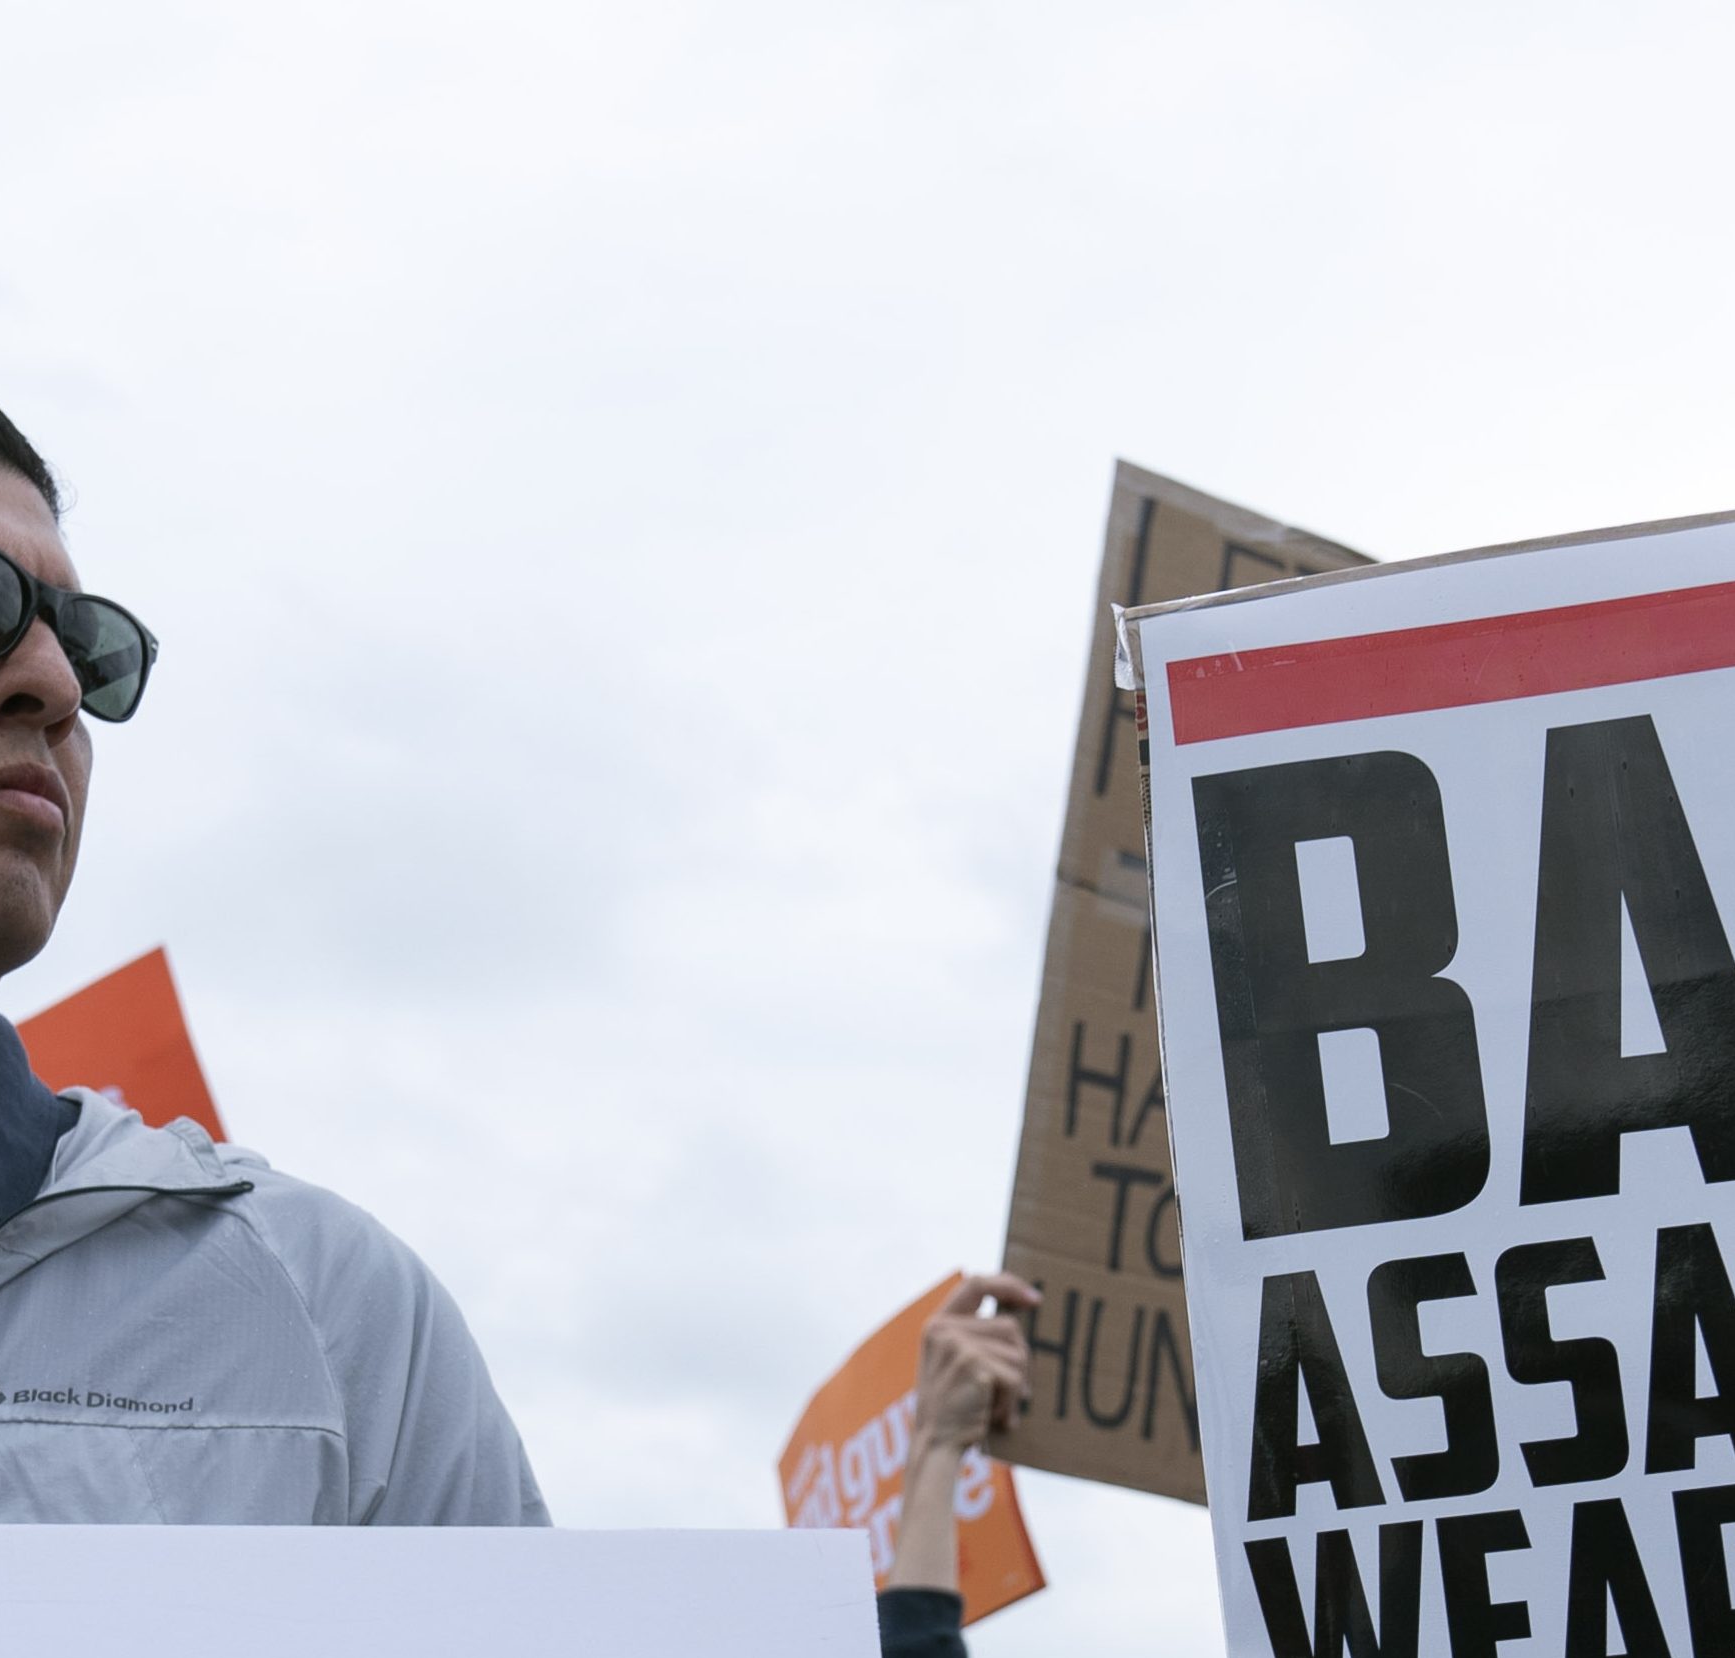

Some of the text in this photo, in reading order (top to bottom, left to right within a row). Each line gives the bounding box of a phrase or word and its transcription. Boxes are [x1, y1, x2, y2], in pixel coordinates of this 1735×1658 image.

[12, 1387, 194, 1414] Black Diamond
[1015, 1282, 1203, 1454] HUN
